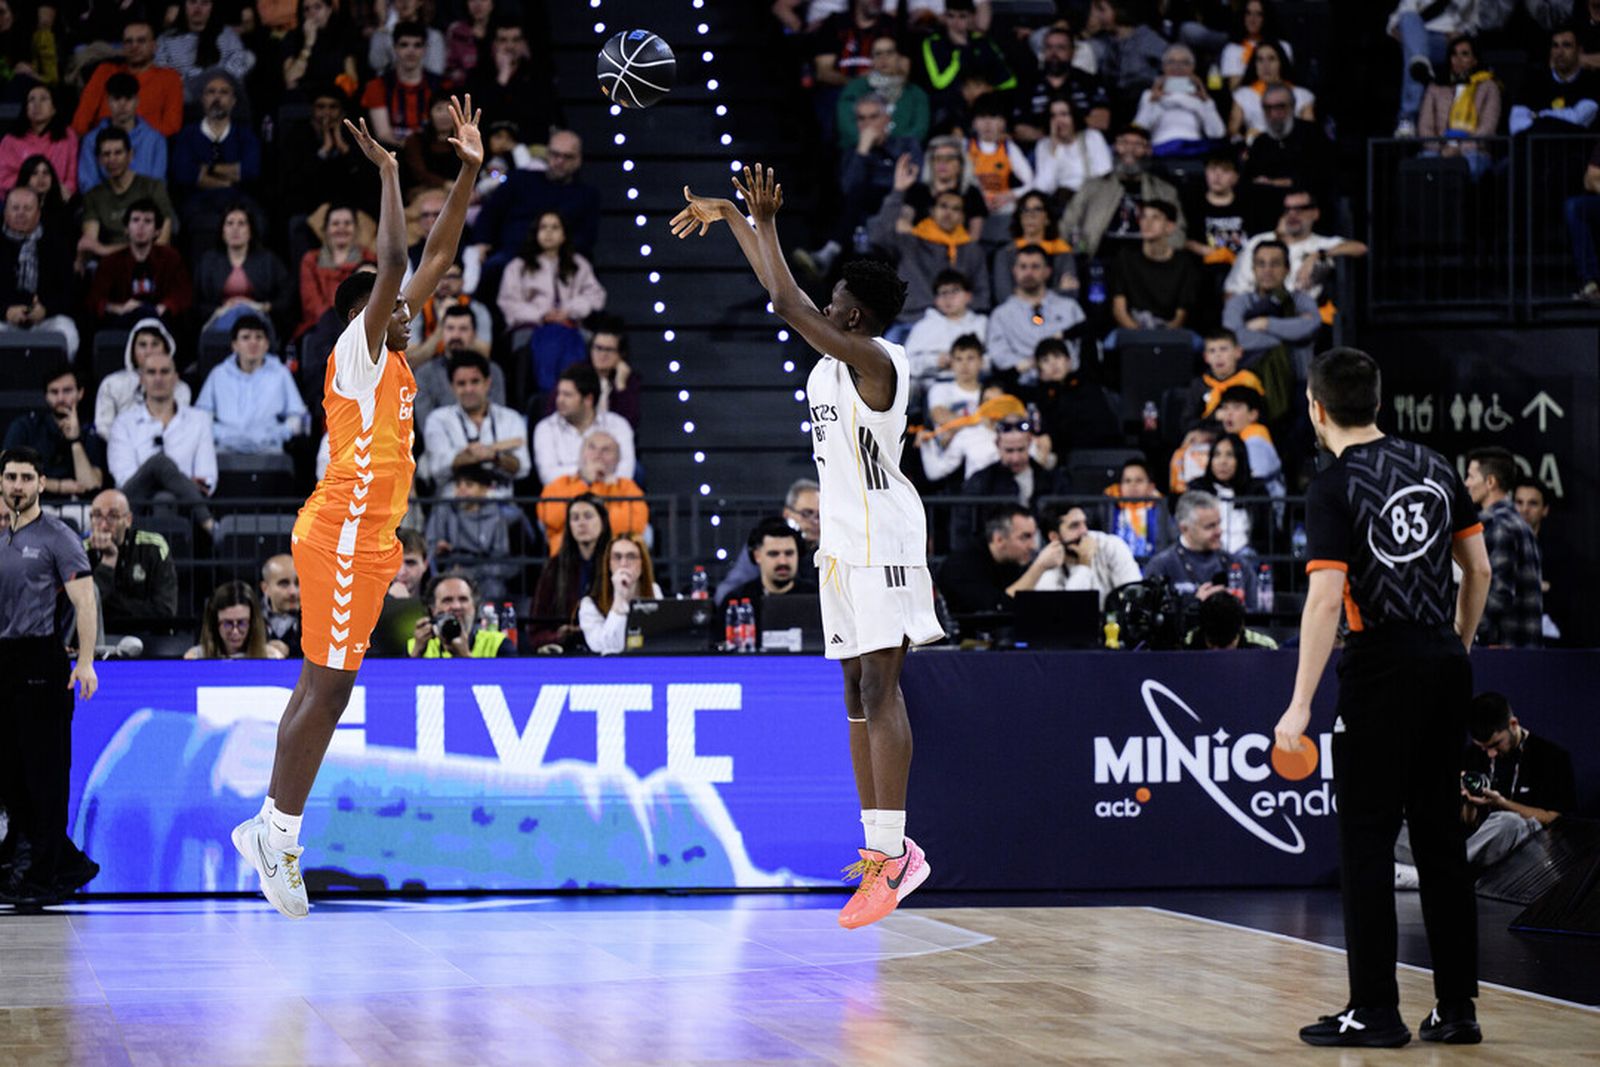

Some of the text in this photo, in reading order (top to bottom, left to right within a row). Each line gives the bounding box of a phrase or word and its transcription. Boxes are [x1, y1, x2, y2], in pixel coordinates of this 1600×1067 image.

[1391, 503, 1428, 544] 83
[1095, 798, 1141, 817] acb
[1250, 782, 1337, 817] end
